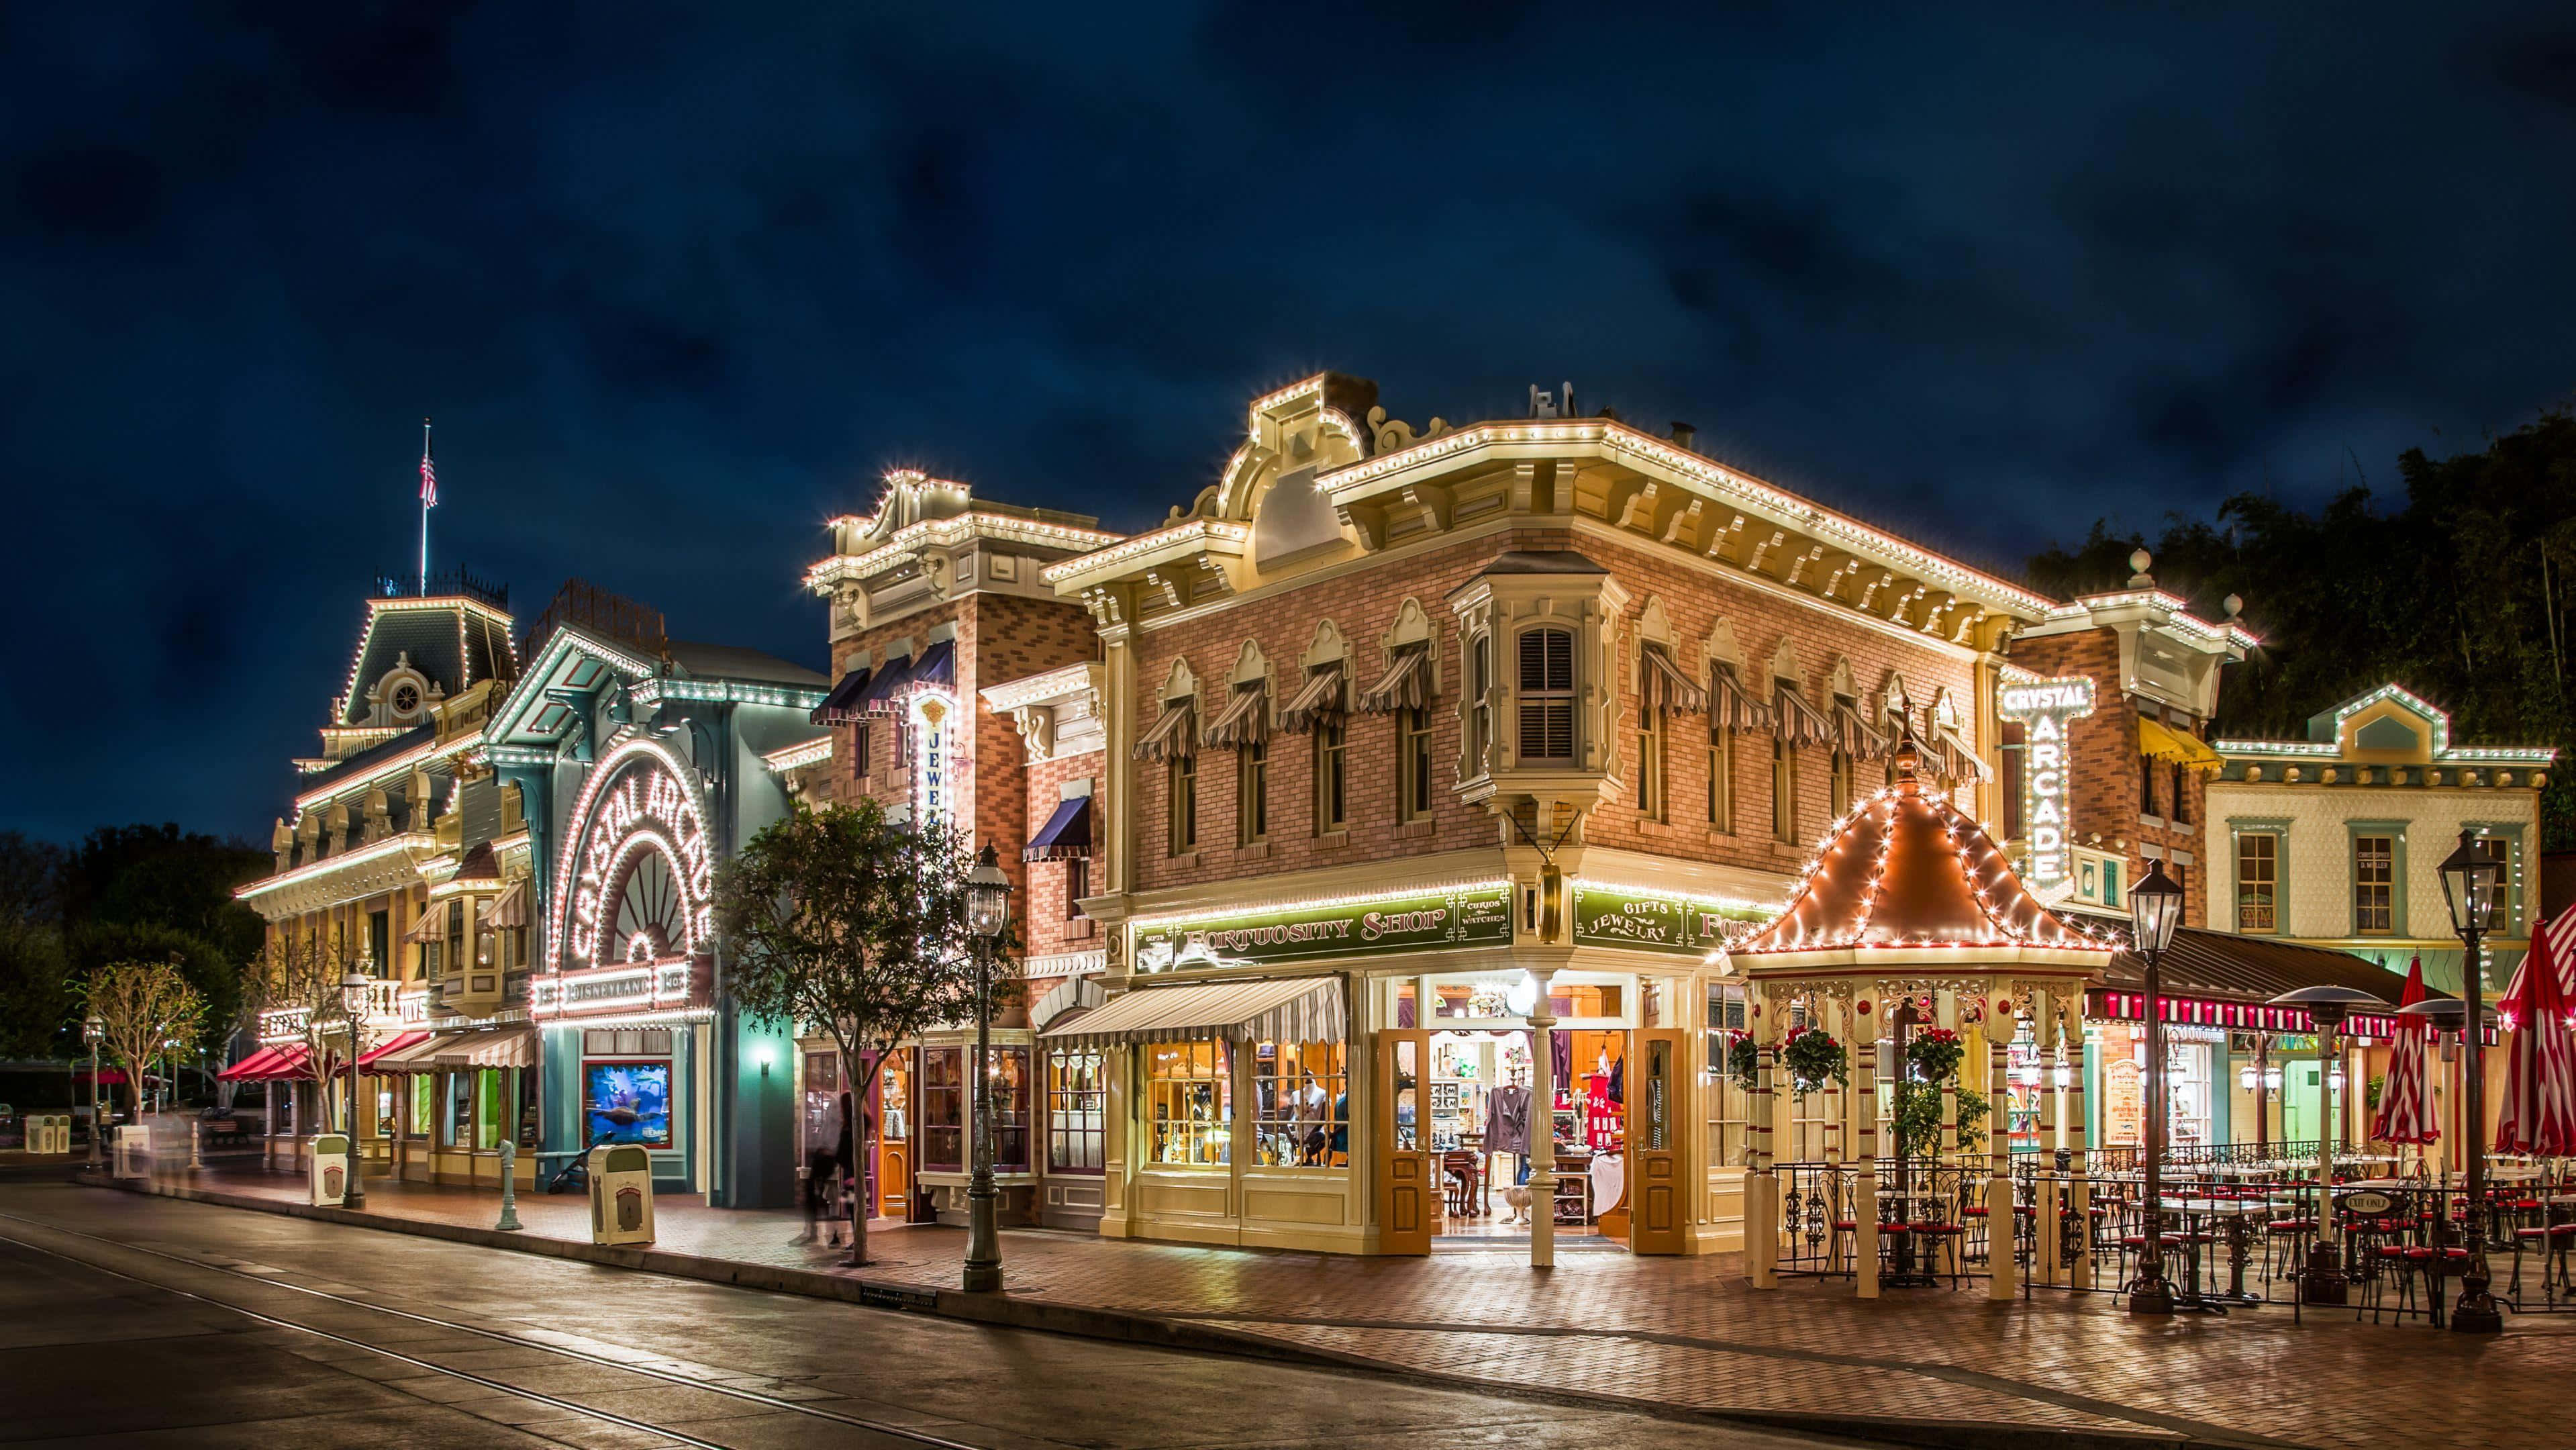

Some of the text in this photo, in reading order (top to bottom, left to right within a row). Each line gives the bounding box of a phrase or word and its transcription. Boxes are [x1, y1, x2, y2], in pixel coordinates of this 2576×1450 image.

[2003, 684, 2088, 710] CRYSTAL
[2031, 715, 2060, 880] ARCADE
[1467, 901, 1501, 910] CURIOS
[1624, 901, 1669, 914] GIFTS
[1184, 909, 1446, 952] FORTUOSITY SHOP
[1462, 914, 1506, 924] WATCHES
[1589, 914, 1668, 941] JEWELRY
[573, 978, 650, 1000] DISNEYLAND
[397, 997, 430, 1024] TOYS
[2349, 1198, 2387, 1208] EXIT ONLY
